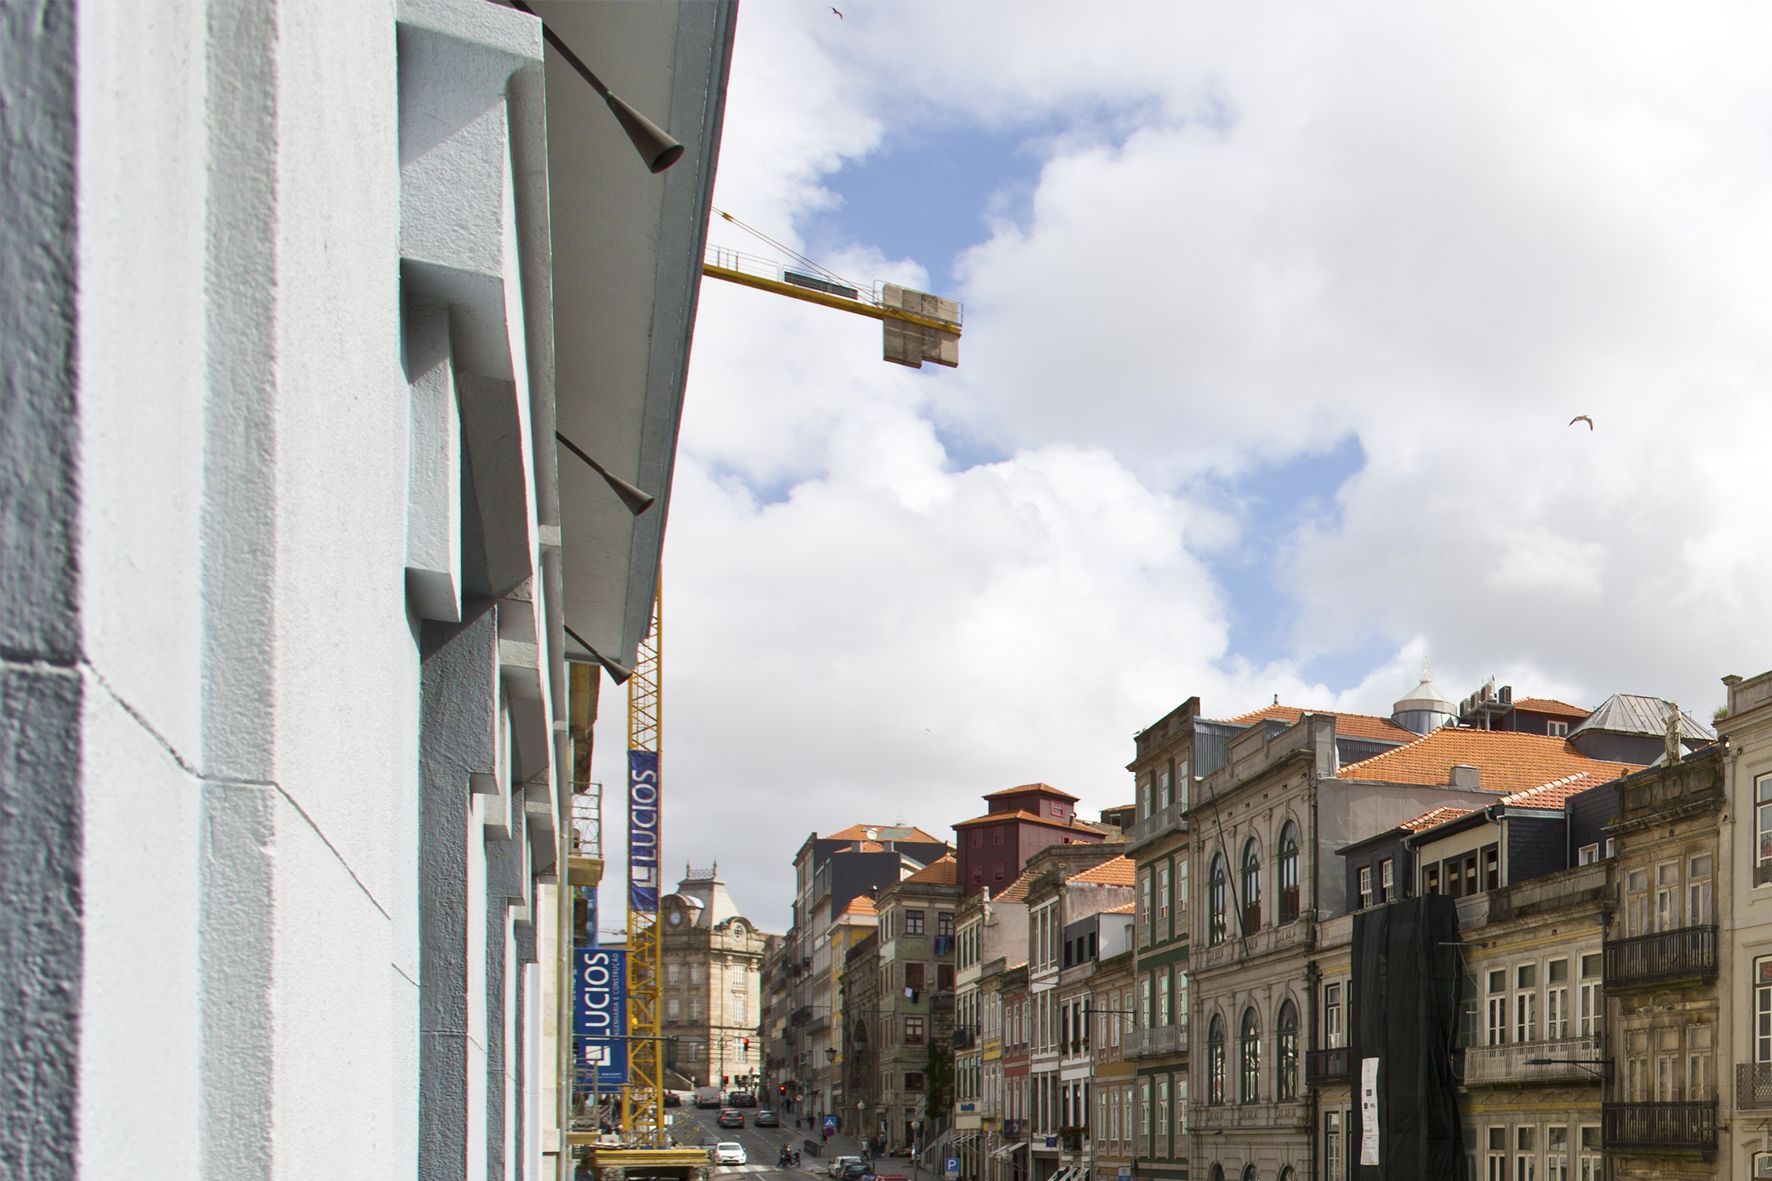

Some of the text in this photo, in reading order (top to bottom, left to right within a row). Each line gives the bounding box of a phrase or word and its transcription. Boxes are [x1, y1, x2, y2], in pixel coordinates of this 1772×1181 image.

[631, 769, 657, 861] LUCIOS
[584, 952, 610, 1040] LUCIOS
[947, 1159, 957, 1170] P
